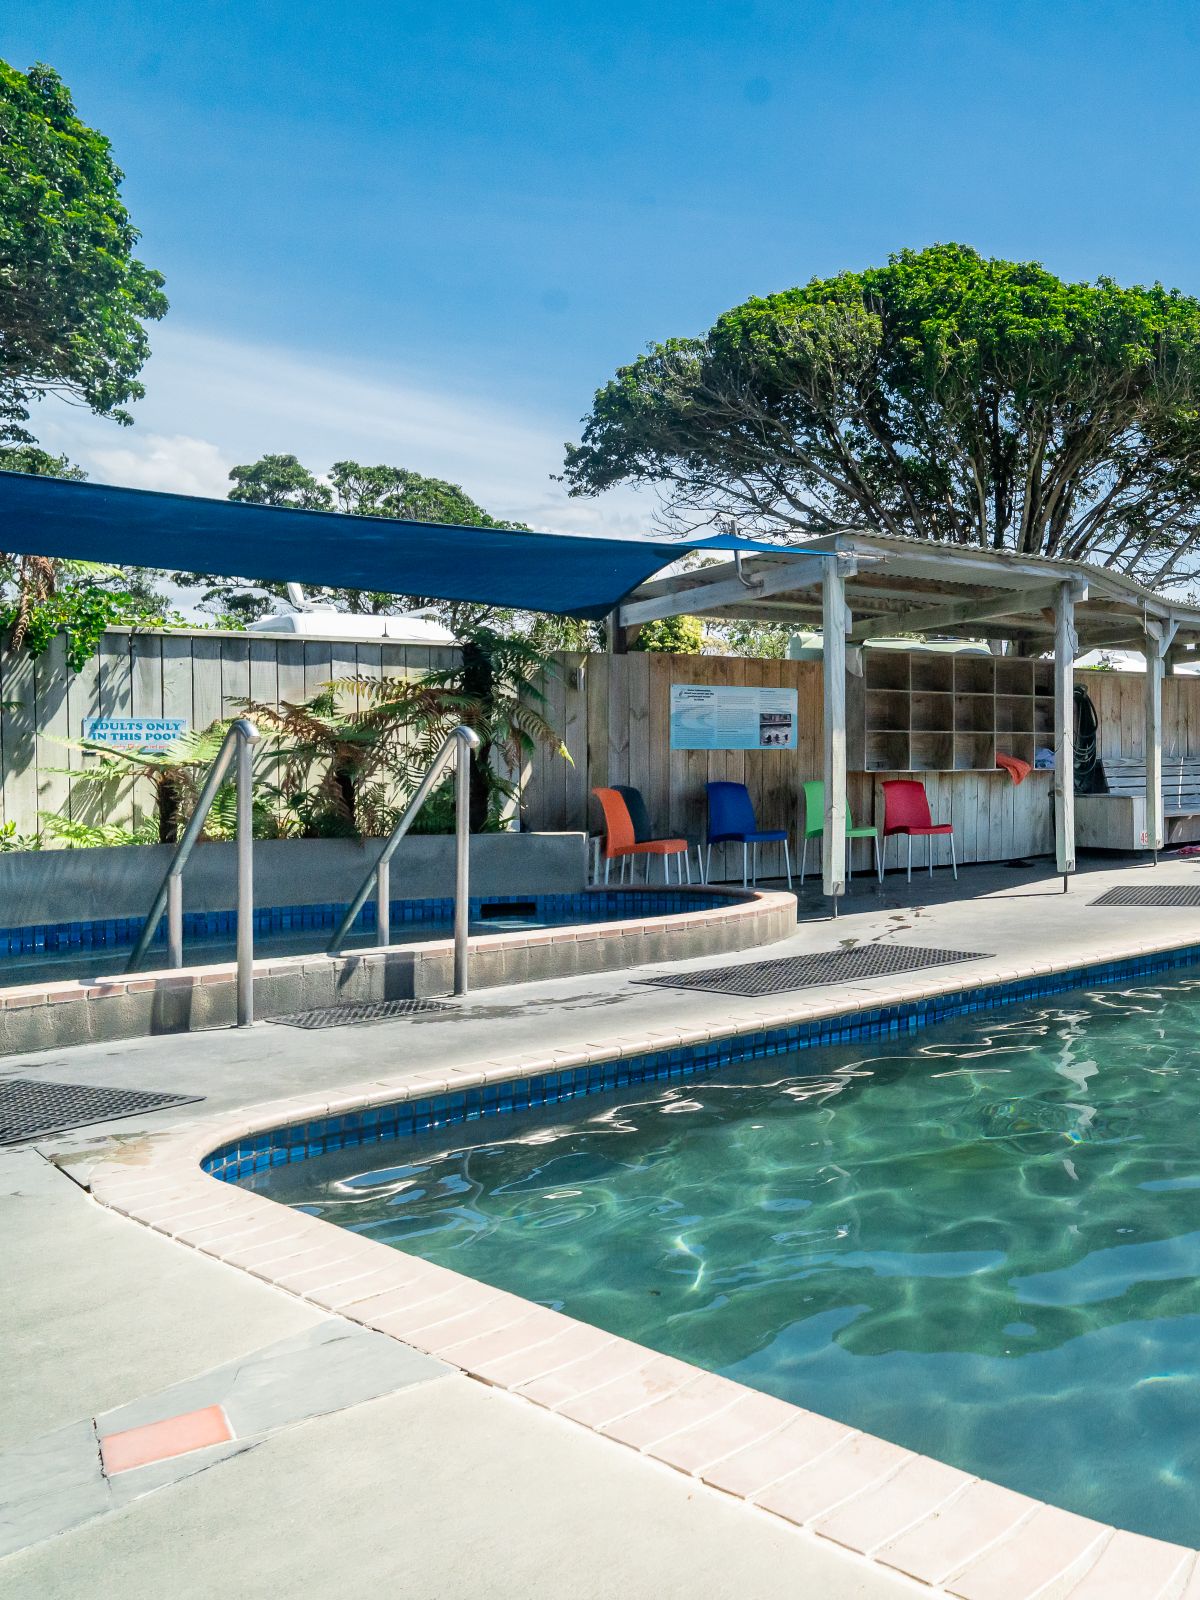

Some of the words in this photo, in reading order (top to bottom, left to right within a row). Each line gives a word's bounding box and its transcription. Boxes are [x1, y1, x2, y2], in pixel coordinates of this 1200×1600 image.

[90, 722, 143, 731] ADULTS
[146, 722, 180, 731] ONLY
[91, 733, 107, 741] IN
[110, 733, 142, 741] THIS
